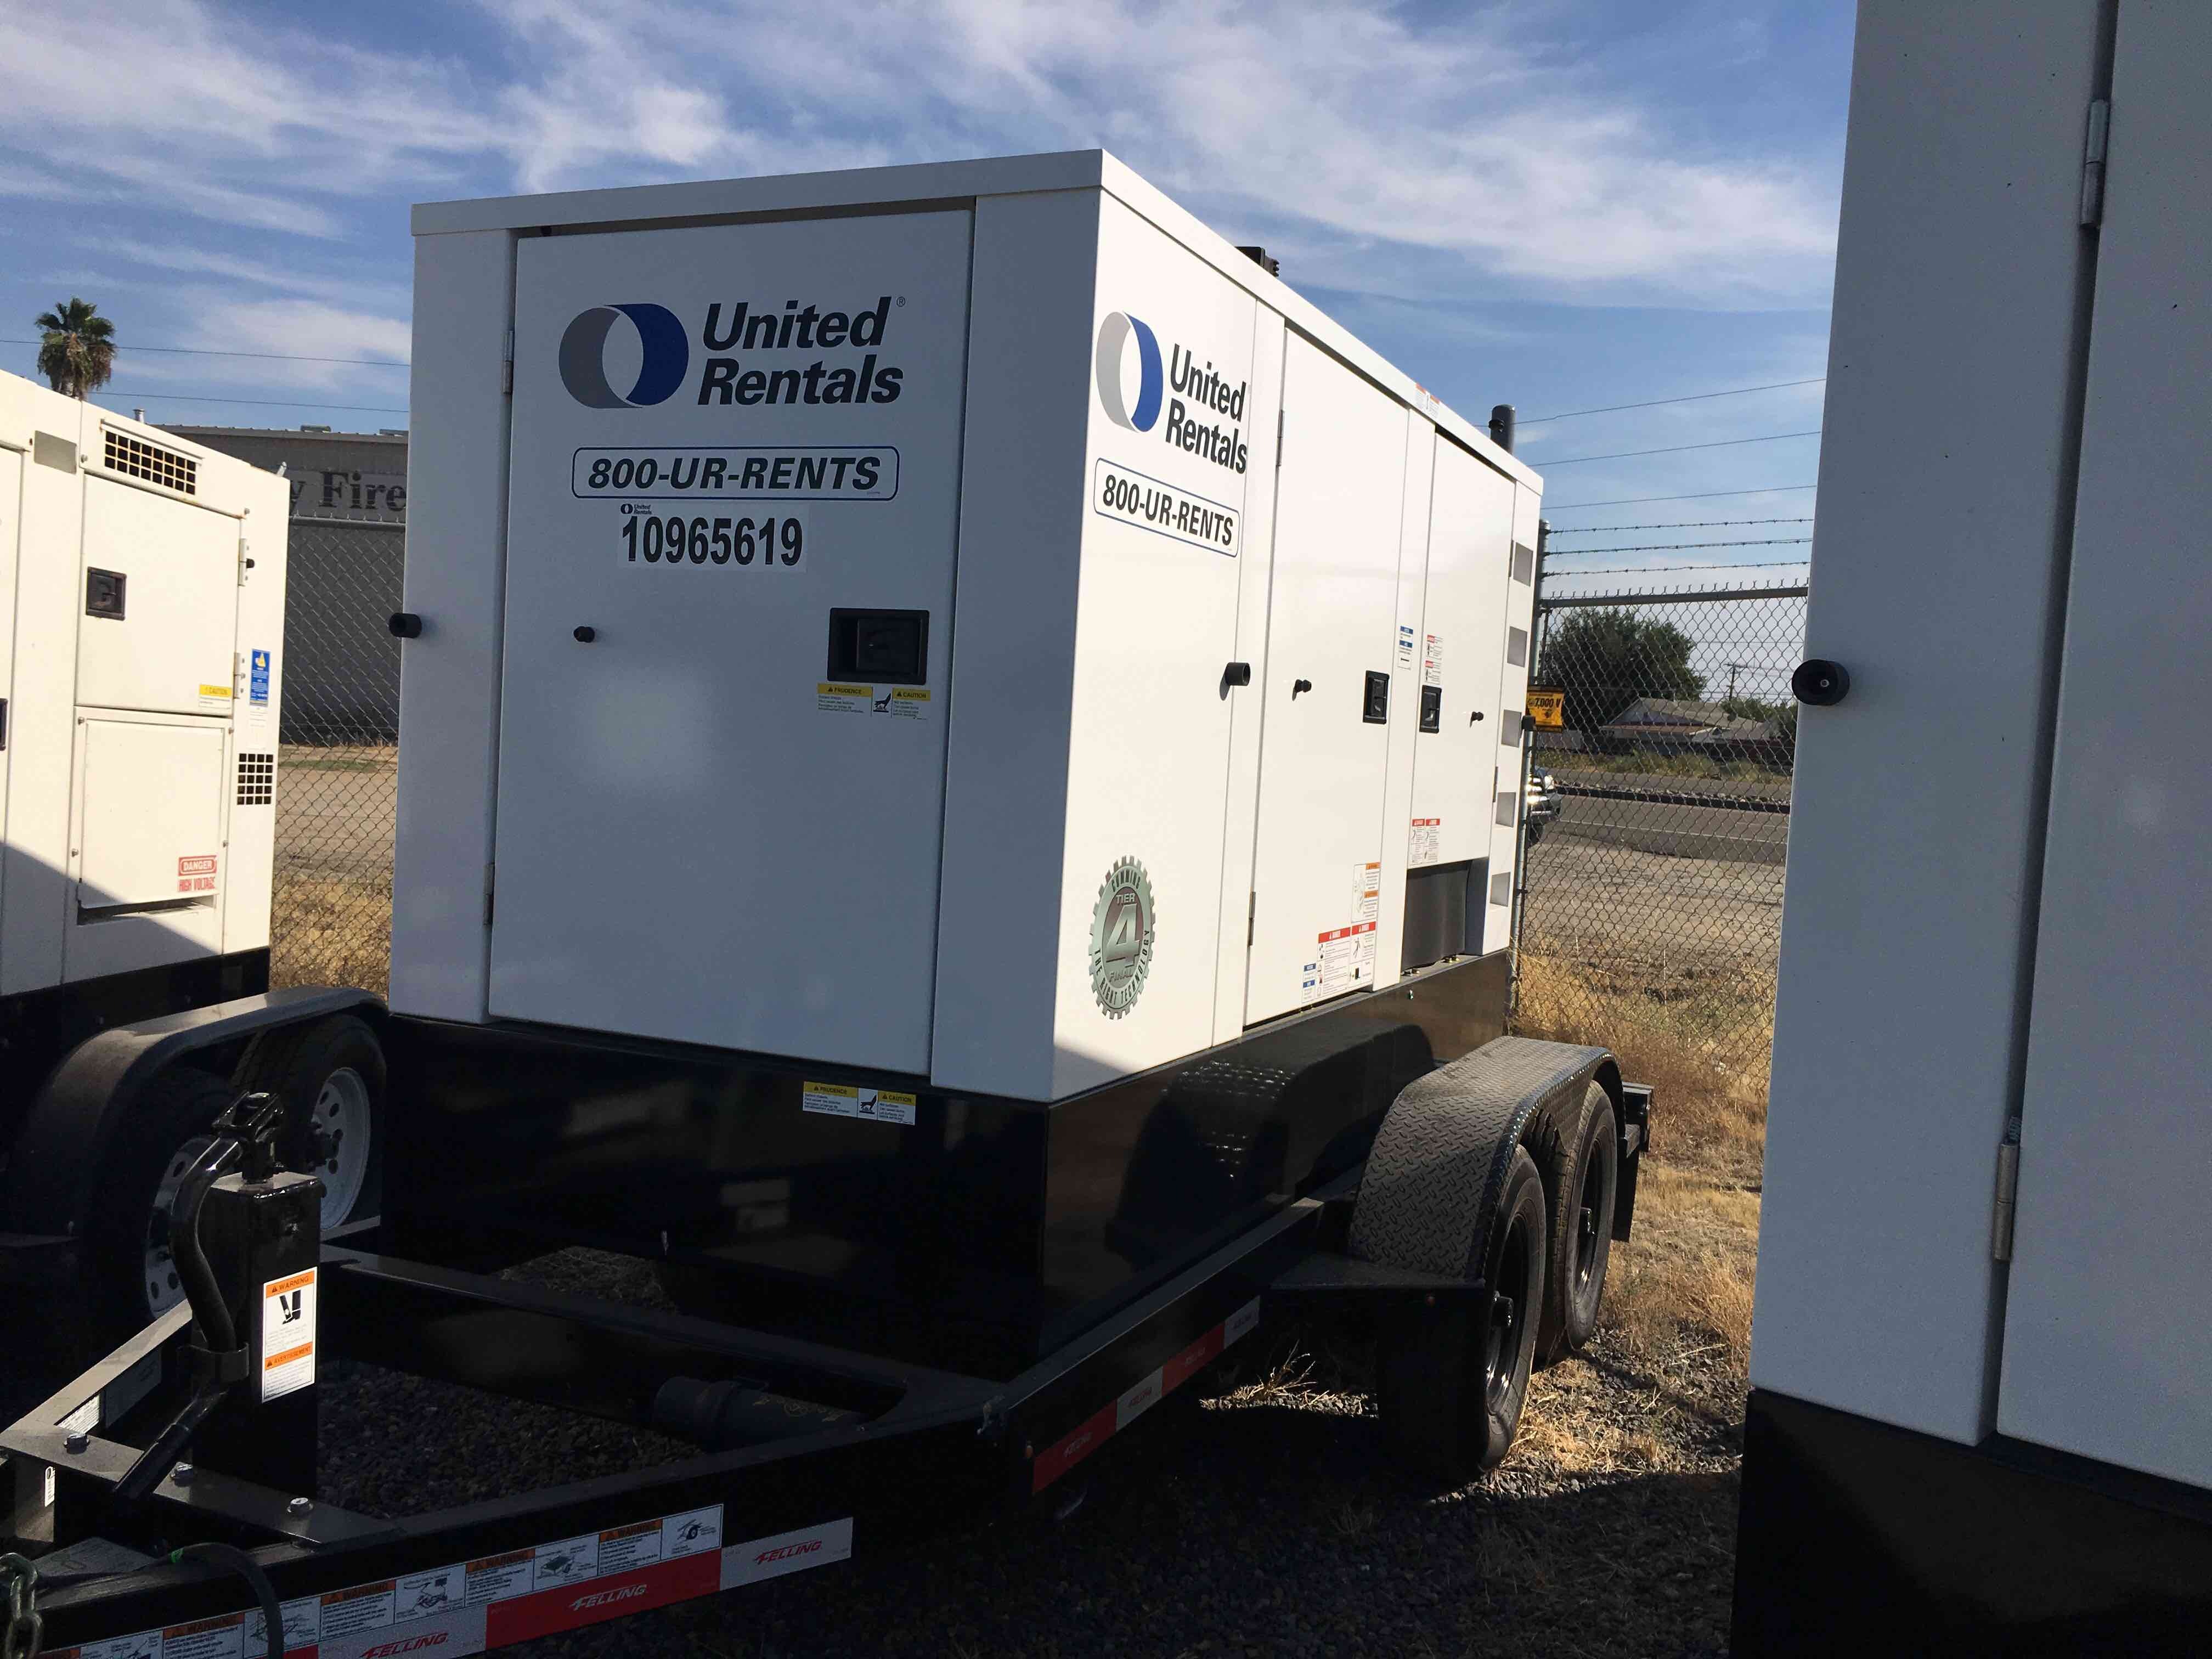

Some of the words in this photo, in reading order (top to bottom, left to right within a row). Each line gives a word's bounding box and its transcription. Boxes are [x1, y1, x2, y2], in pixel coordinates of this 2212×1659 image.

[703, 296, 892, 351] United
[697, 354, 904, 405] Rentals
[1170, 343, 1246, 422] United
[1165, 397, 1248, 475] Rentals
[588, 456, 881, 490] 800-UR-RENTS
[318, 471, 407, 512] Fire
[1103, 474, 1233, 546] 800-UR-RENTS
[622, 516, 803, 566] 10965619
[1535, 697, 1554, 709] 7,000
[1555, 697, 1561, 708] V
[183, 860, 212, 871] DANGER
[1115, 893, 1137, 905] TIER
[1094, 948, 1103, 974] THE
[1099, 978, 1118, 1005] RIGHT
[1121, 930, 1150, 1004] TECHNOLOGY
[1109, 969, 1133, 983] FINAL
[888, 1094, 912, 1103] CAUTION
[278, 1276, 309, 1292] WARNING
[754, 1539, 822, 1565] FELLING
[568, 1584, 647, 1611] FELLING
[359, 1632, 449, 1659] FELLING
